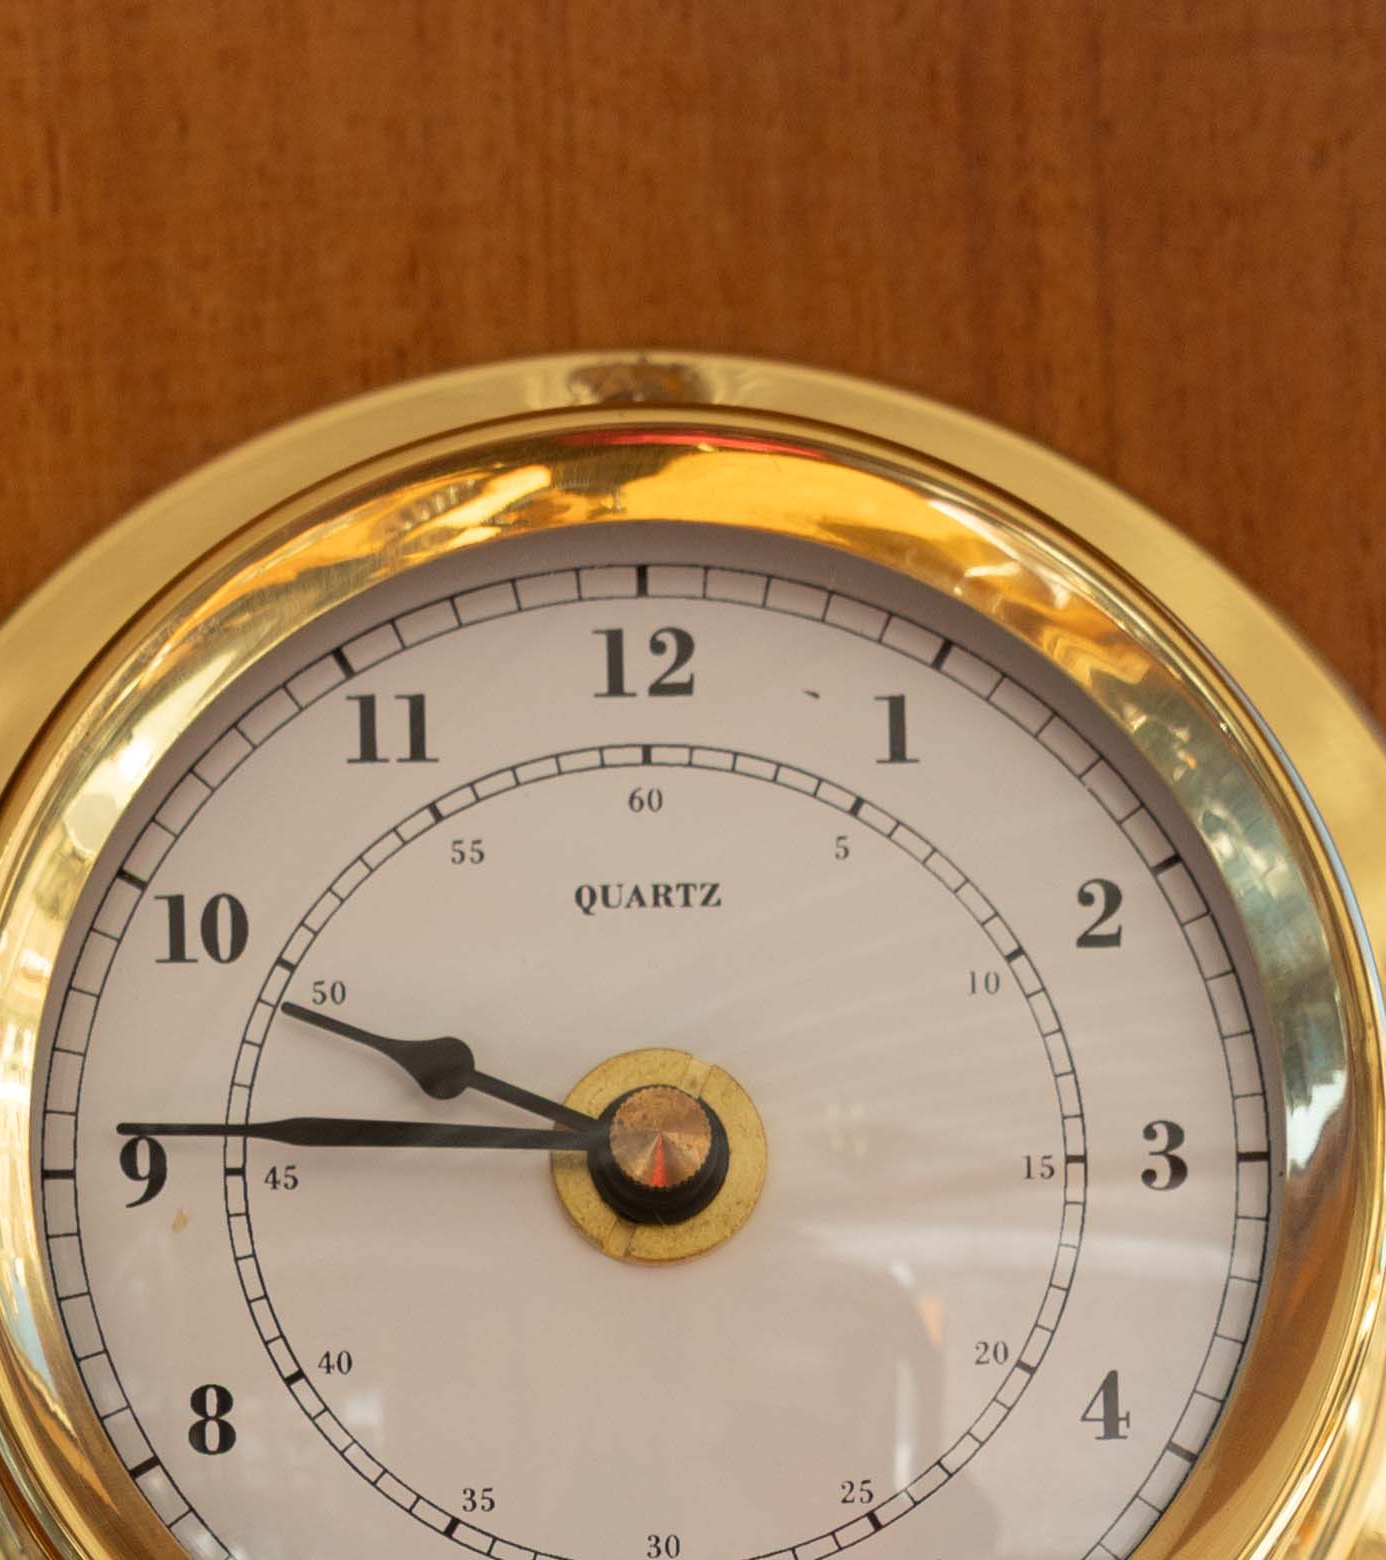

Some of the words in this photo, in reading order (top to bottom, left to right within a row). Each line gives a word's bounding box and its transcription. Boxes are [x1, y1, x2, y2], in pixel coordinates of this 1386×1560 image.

[592, 626, 696, 699] 12
[345, 694, 439, 764] 11
[874, 694, 919, 765] 1
[627, 787, 664, 814] 60
[451, 839, 485, 866] 55
[835, 836, 851, 862] 5
[574, 880, 723, 914] QUARTZ
[1075, 877, 1124, 949] 2
[153, 892, 250, 965] 10
[311, 978, 347, 1006] 50
[967, 970, 1001, 997] 10
[119, 1130, 168, 1208] 9
[1022, 1155, 1056, 1181] 15
[1140, 1121, 1189, 1192] 3
[263, 1165, 299, 1192] 45
[318, 1349, 353, 1375] 40
[975, 1340, 1010, 1366] 20
[188, 1383, 237, 1456] 8
[1079, 1369, 1131, 1441] 4
[462, 1485, 496, 1514] 35
[840, 1478, 875, 1507] 25
[646, 1534, 681, 1560] 30
